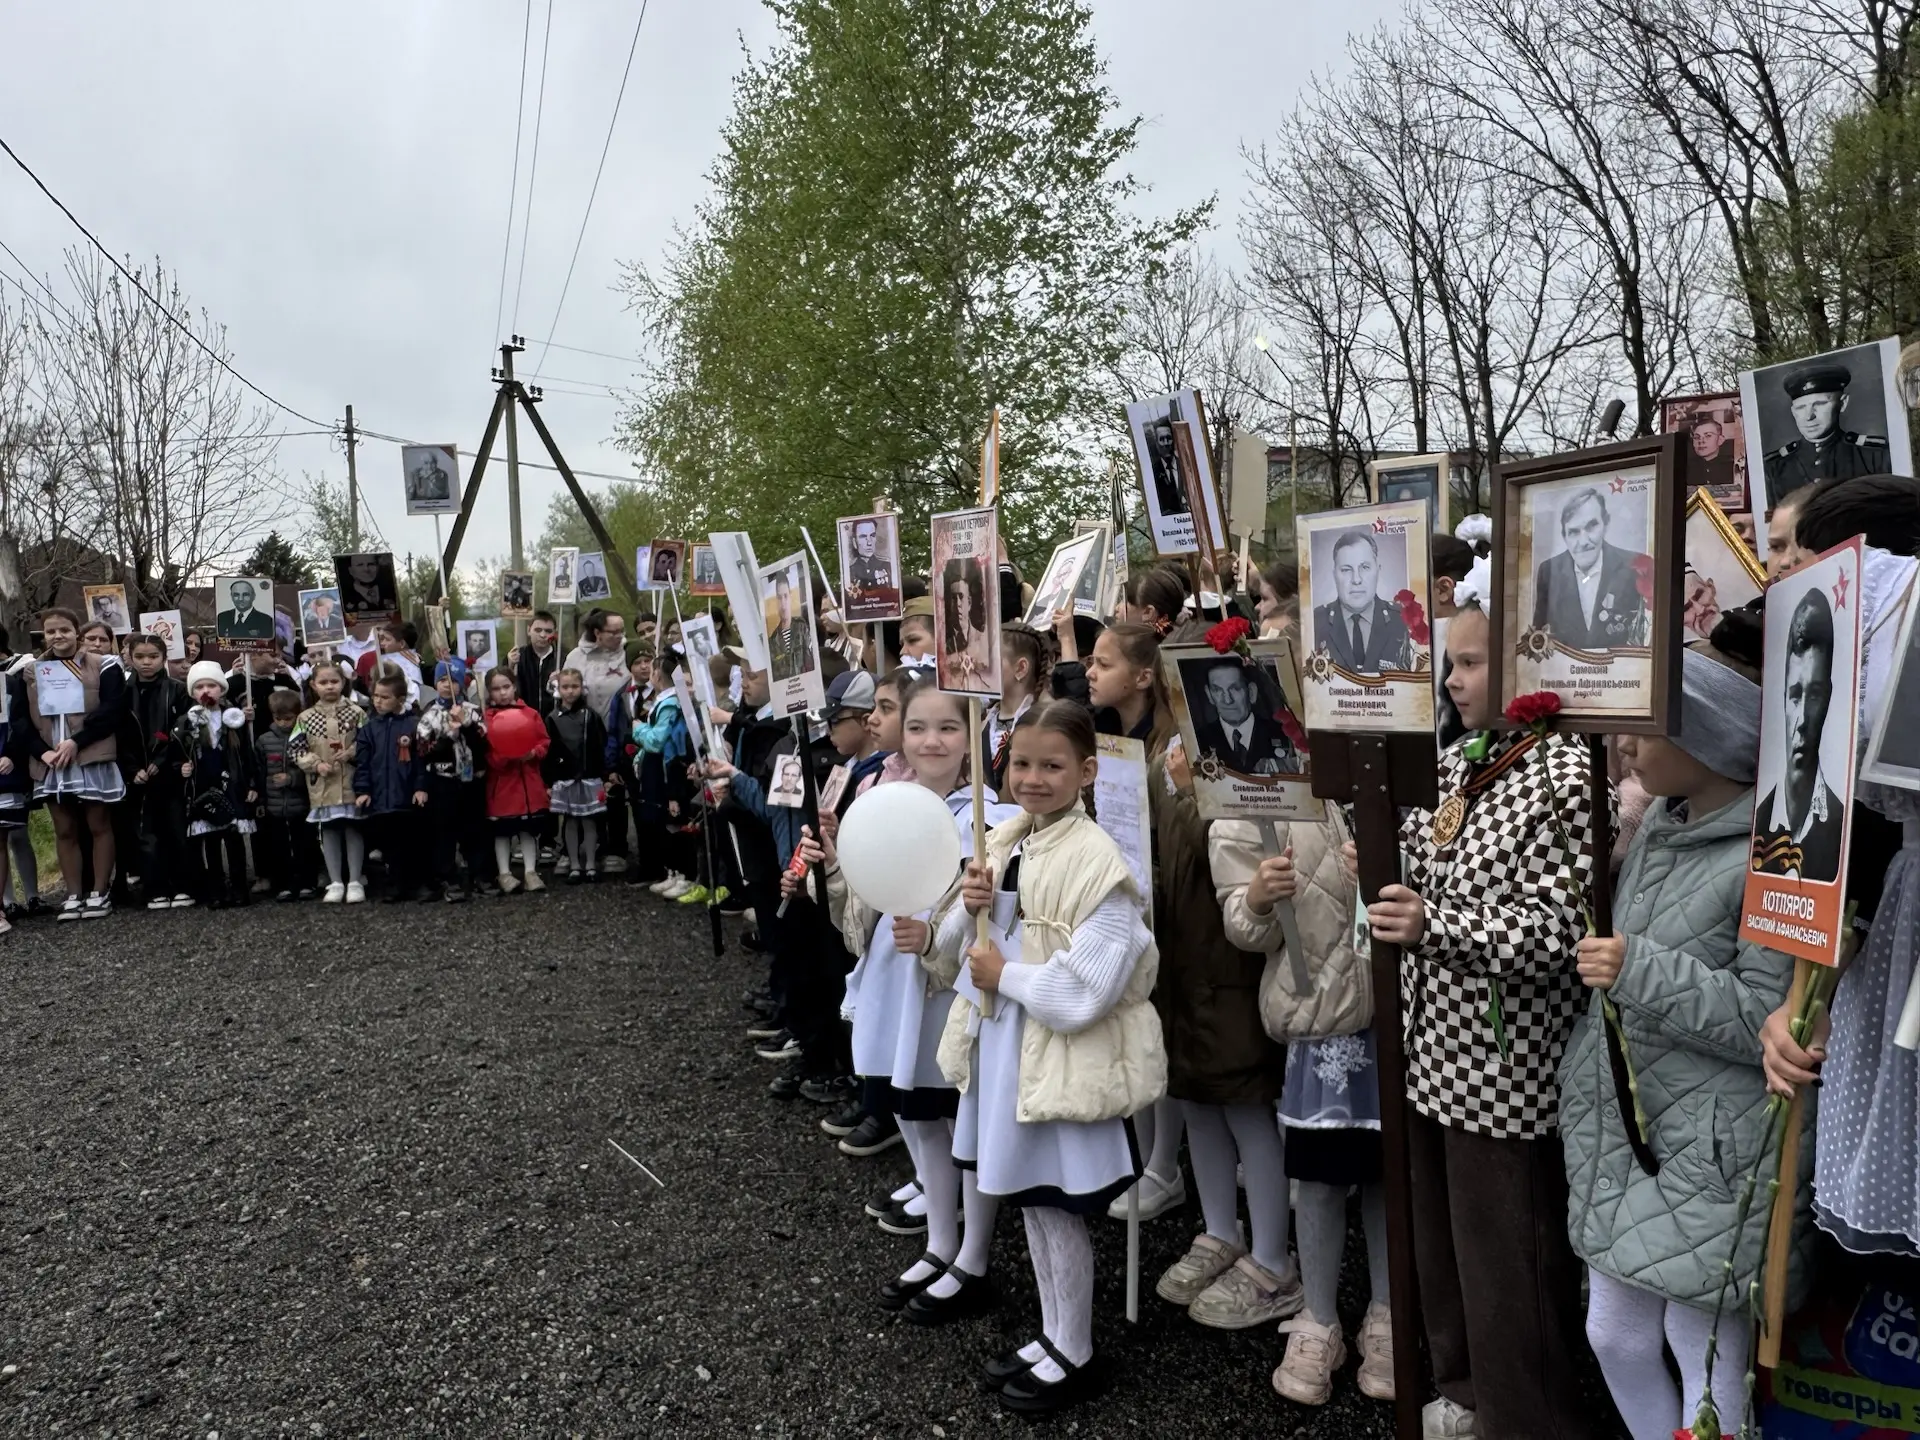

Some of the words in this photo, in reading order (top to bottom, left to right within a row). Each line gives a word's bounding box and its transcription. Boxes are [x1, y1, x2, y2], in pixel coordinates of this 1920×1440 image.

[1762, 889, 1815, 921] КОТЛЯРОВ
[1746, 914, 1776, 934] ВАСИЛИЙ
[1776, 920, 1828, 948] АФАНАСЬЕВИЧ
[1783, 1374, 1902, 1421] товары
